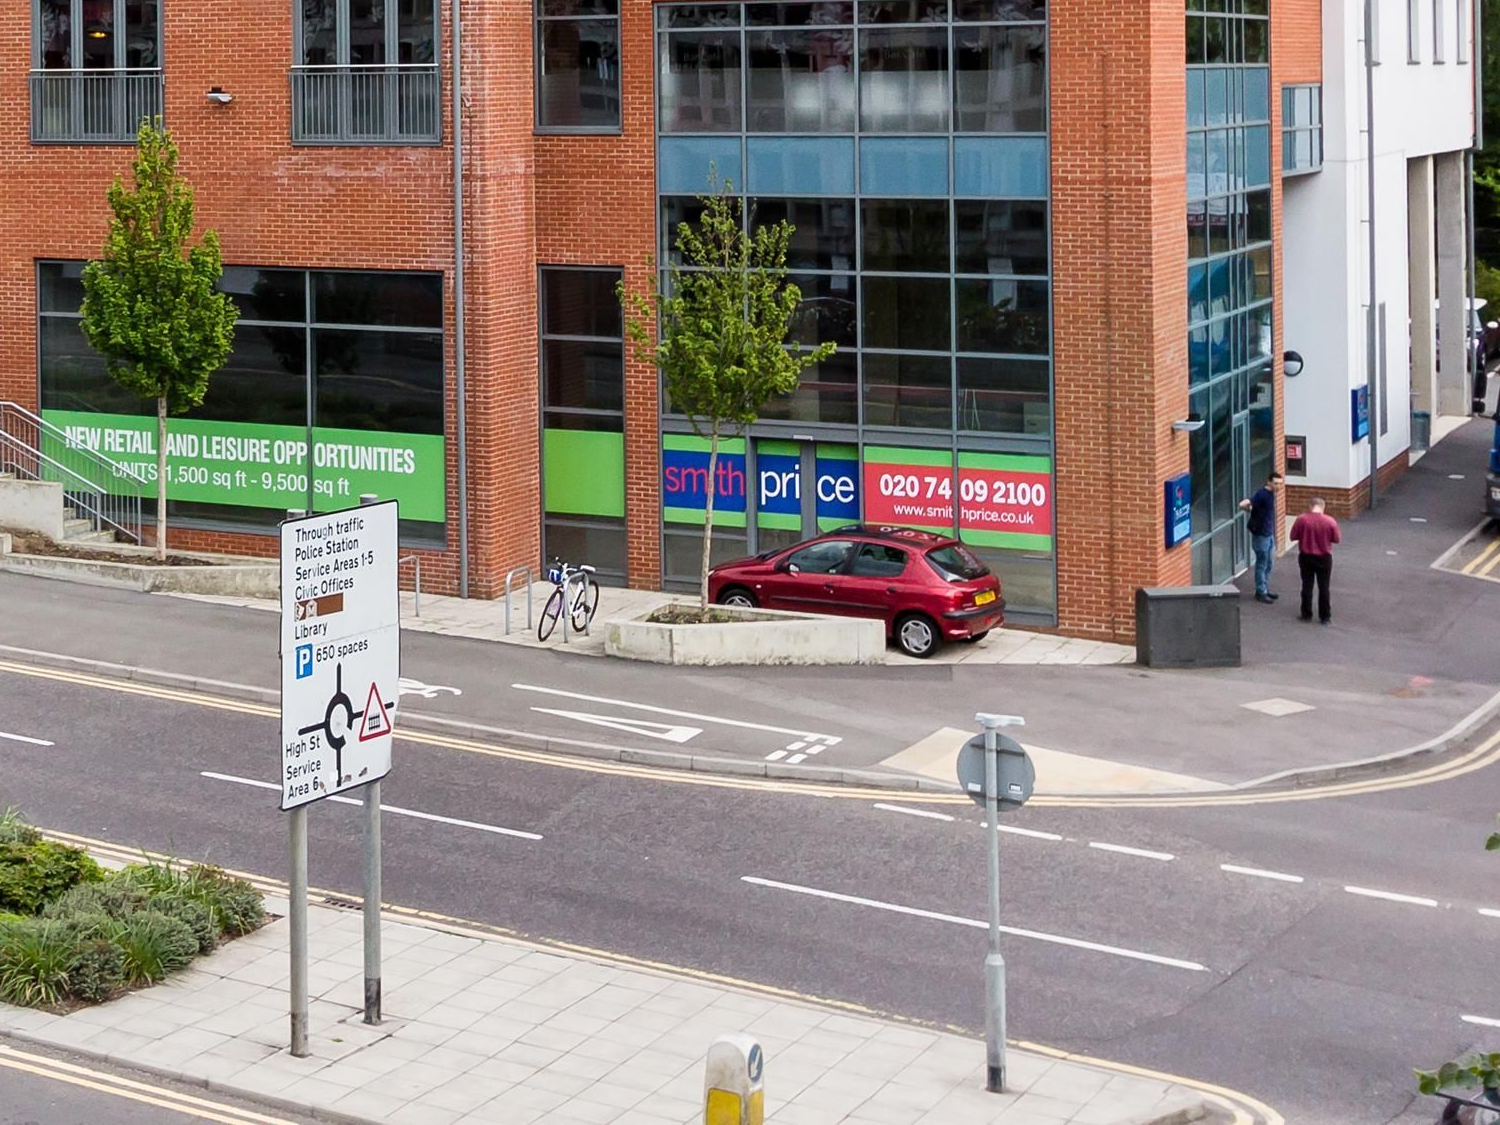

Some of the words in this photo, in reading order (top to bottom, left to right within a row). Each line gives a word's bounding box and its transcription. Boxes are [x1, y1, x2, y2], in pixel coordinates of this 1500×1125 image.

[65, 426, 101, 451] NEW
[104, 428, 156, 455] RETAIL
[165, 433, 199, 458] AND
[202, 435, 270, 463] LEISURE
[274, 440, 415, 474] OPPORTUNITIES
[112, 461, 157, 481] UNITS
[165, 465, 208, 486] 1,500
[212, 471, 231, 490] sq
[234, 470, 247, 488] ft
[261, 472, 308, 492] 9,500
[314, 479, 334, 497] sq
[338, 478, 350, 495] ft
[880, 474, 920, 498] 020
[924, 476, 988, 502] 7409
[992, 481, 1046, 507] 2100
[893, 505, 1034, 524] www.smithprice.co.uk
[295, 523, 333, 543] Through
[336, 517, 364, 535] traffic
[295, 545, 323, 562] Police
[326, 538, 359, 555] Station
[295, 563, 330, 581] Service
[333, 557, 359, 573] Areas
[361, 550, 374, 566] 1-5
[295, 584, 318, 601] Civic
[320, 577, 354, 594] Offices
[295, 622, 328, 640] Library
[316, 645, 335, 663] 650
[337, 639, 368, 658] spaces
[285, 741, 306, 758] High
[309, 736, 320, 750] St
[286, 759, 321, 780] Service
[287, 783, 309, 800] Area
[312, 776, 319, 791] 6
